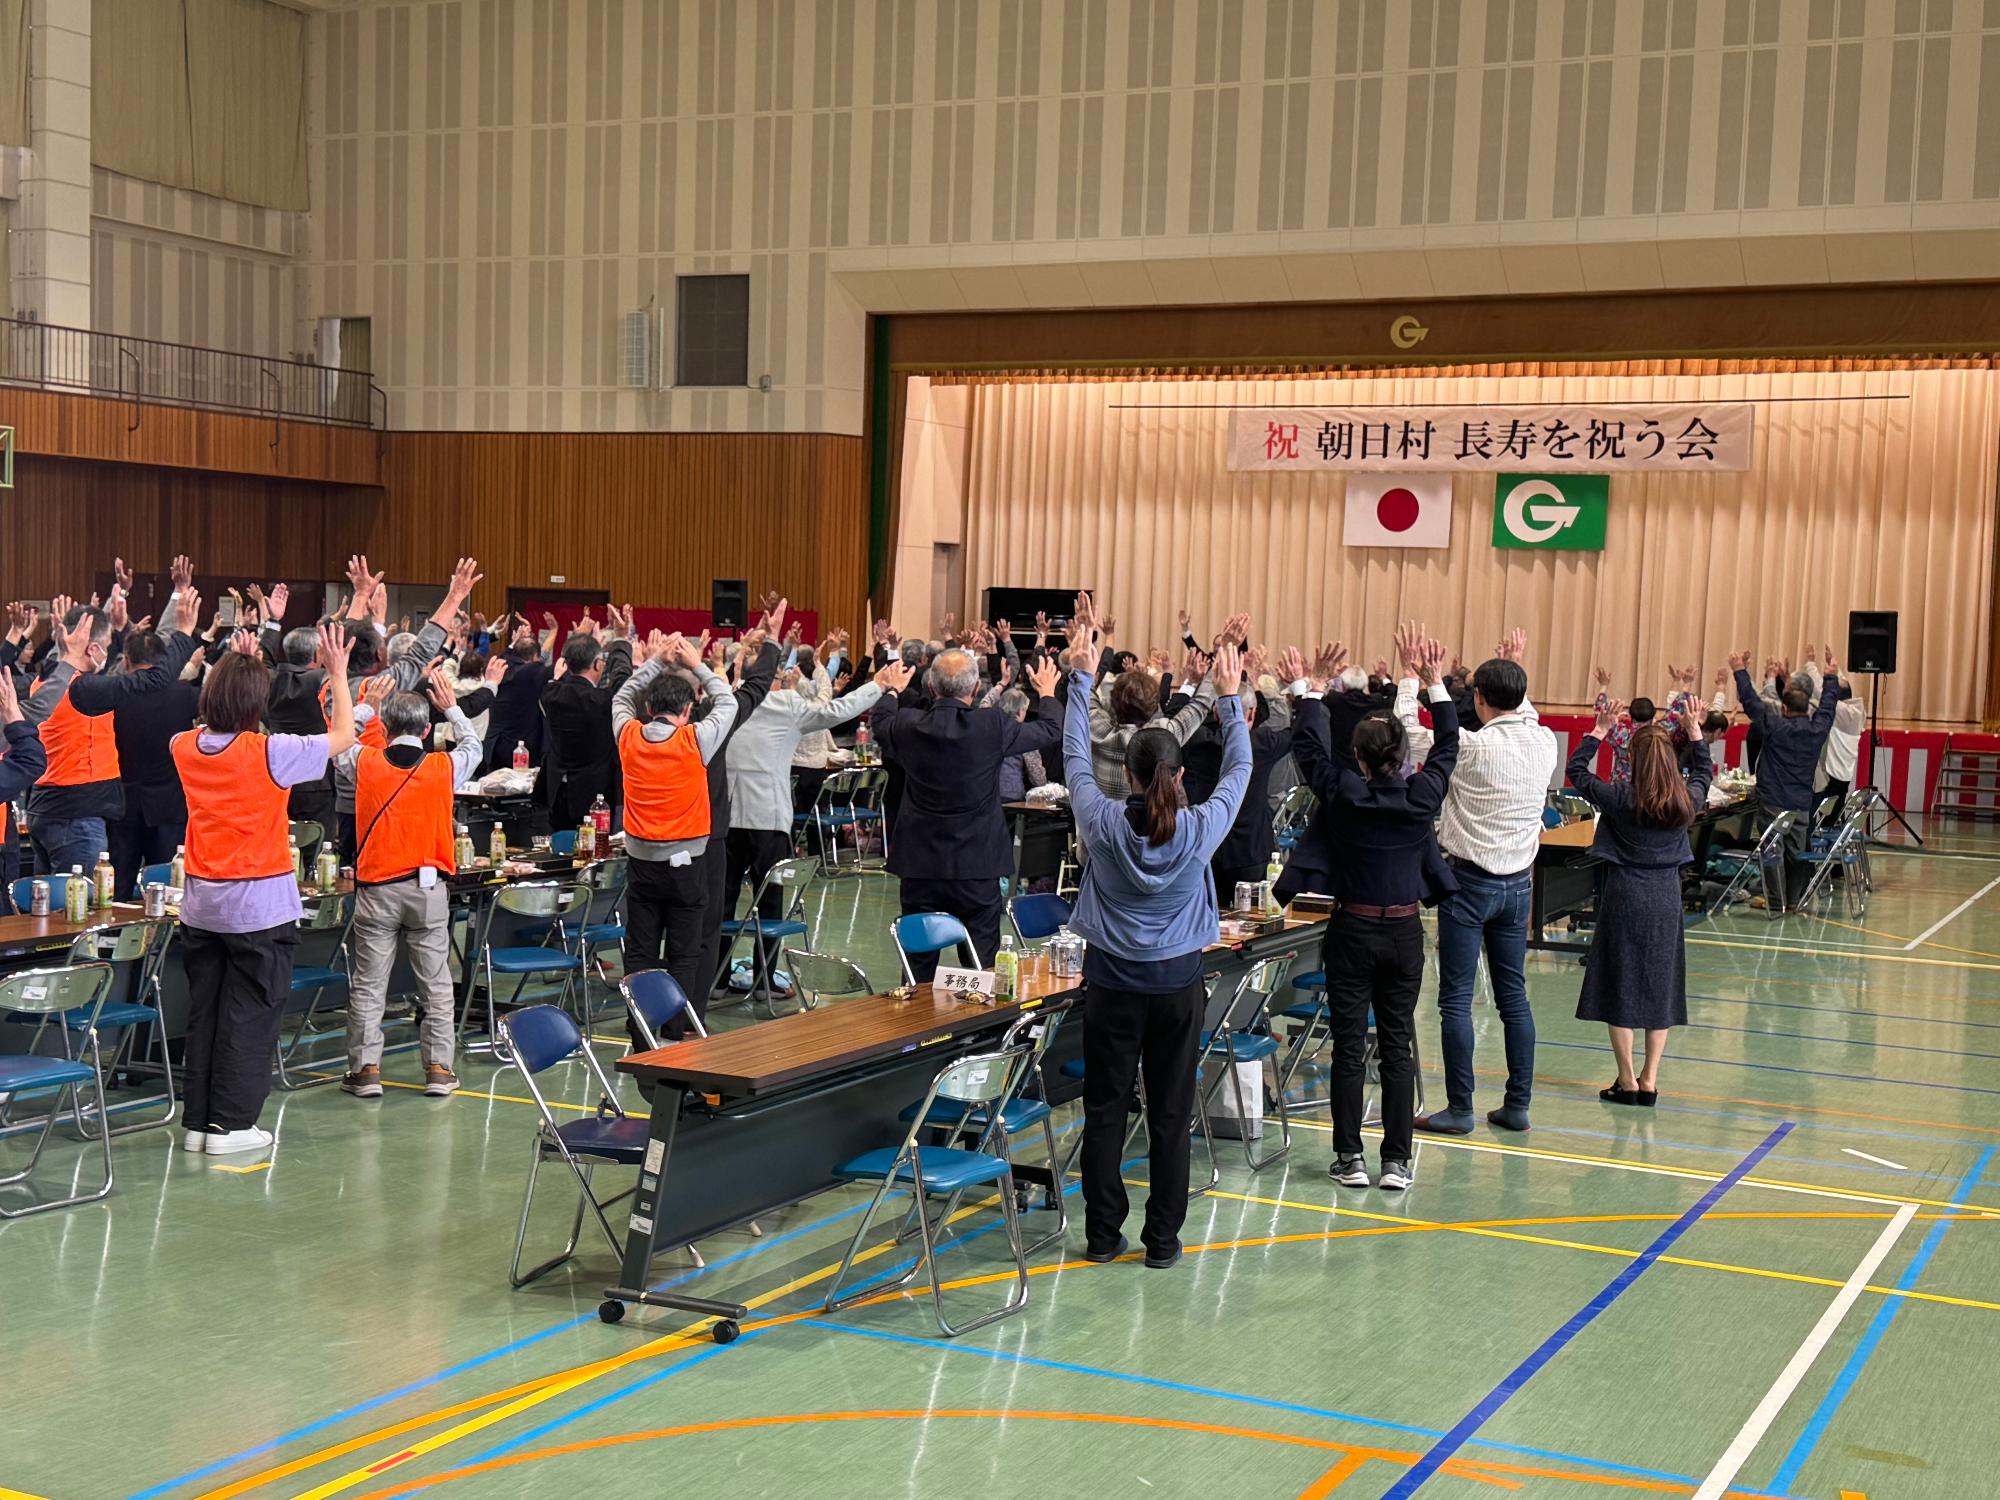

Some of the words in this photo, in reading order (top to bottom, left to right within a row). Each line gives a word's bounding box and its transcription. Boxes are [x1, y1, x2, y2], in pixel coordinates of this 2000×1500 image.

[1262, 420, 1299, 461] 祝
[1315, 419, 1437, 460] 朝日村
[1453, 416, 1720, 461] 長寿を祝う会
[943, 973, 981, 990] 事務局
